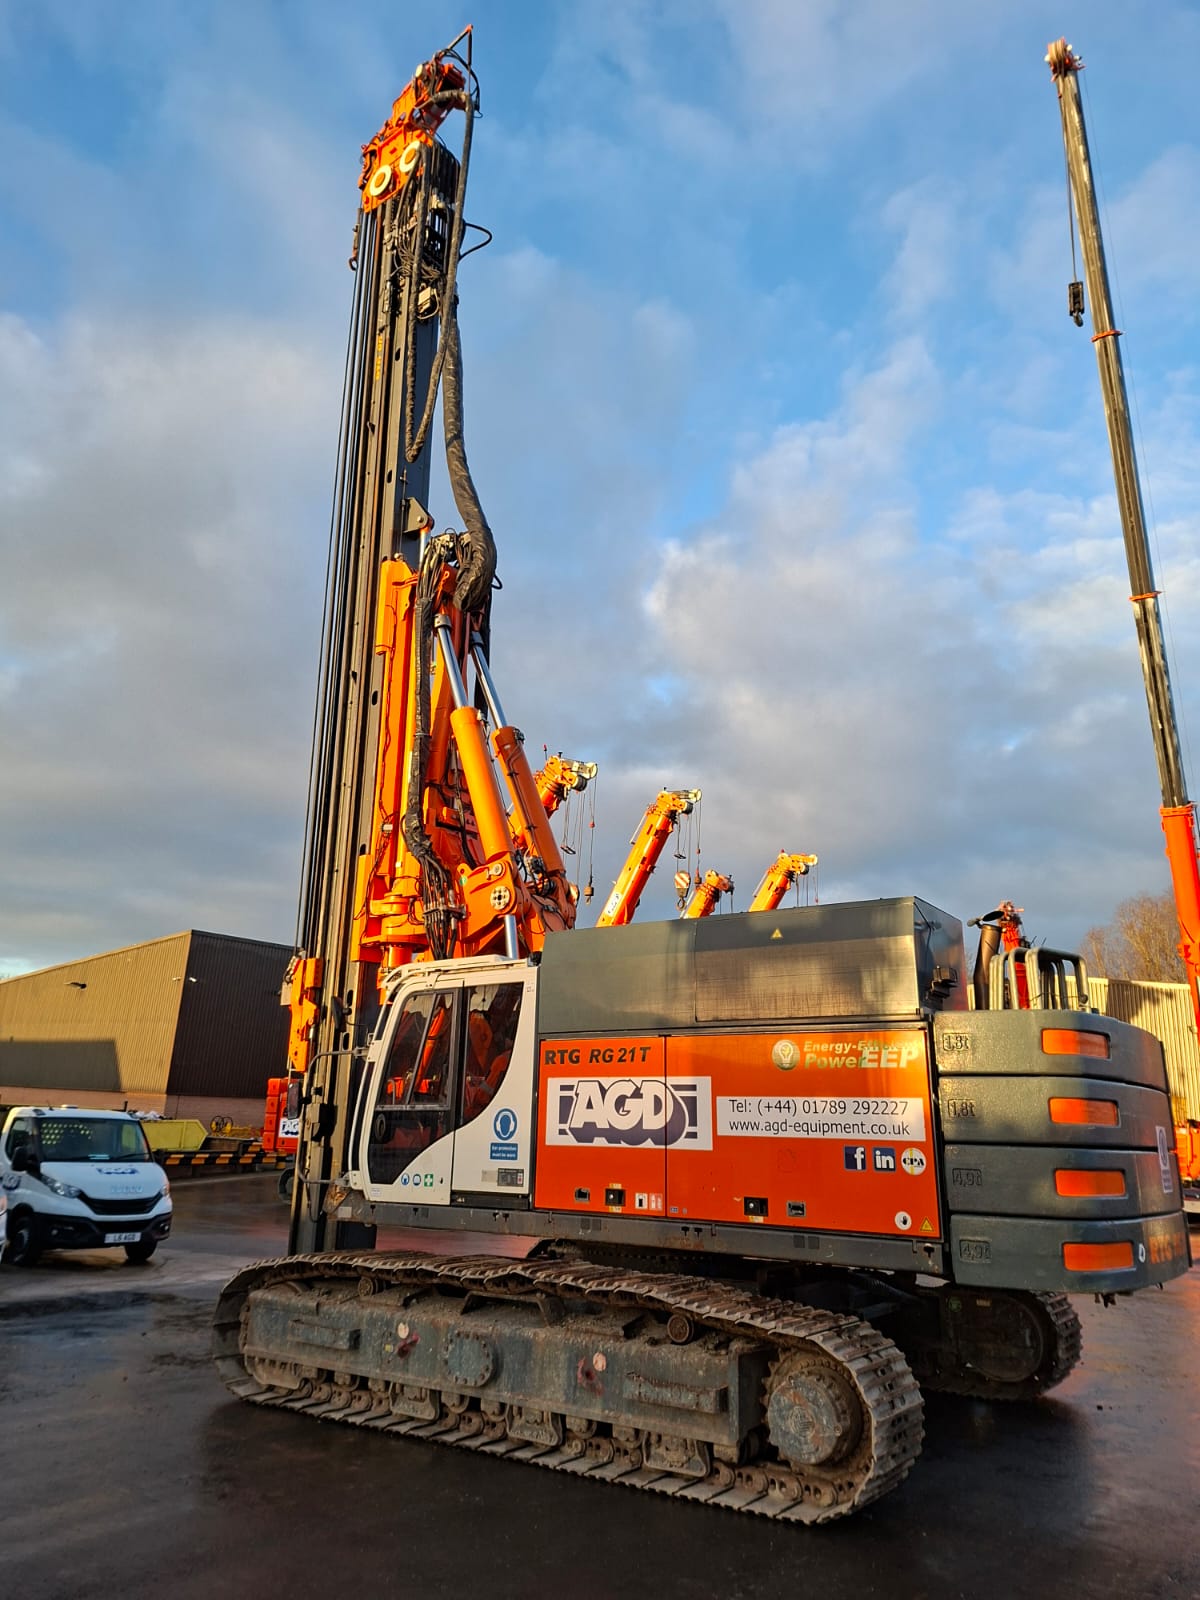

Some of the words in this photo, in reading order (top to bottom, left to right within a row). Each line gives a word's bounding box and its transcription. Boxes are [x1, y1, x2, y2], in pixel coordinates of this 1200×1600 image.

[544, 1049, 580, 1065] RTG
[861, 1046, 919, 1069] EEP
[568, 1079, 682, 1141] AGD
[728, 1099, 752, 1113] Tel:
[757, 1098, 797, 1117] (+44)
[802, 1100, 847, 1115] 01789
[852, 1100, 909, 1116] 292227
[729, 1118, 910, 1136] www.agd-equipment.co.uk
